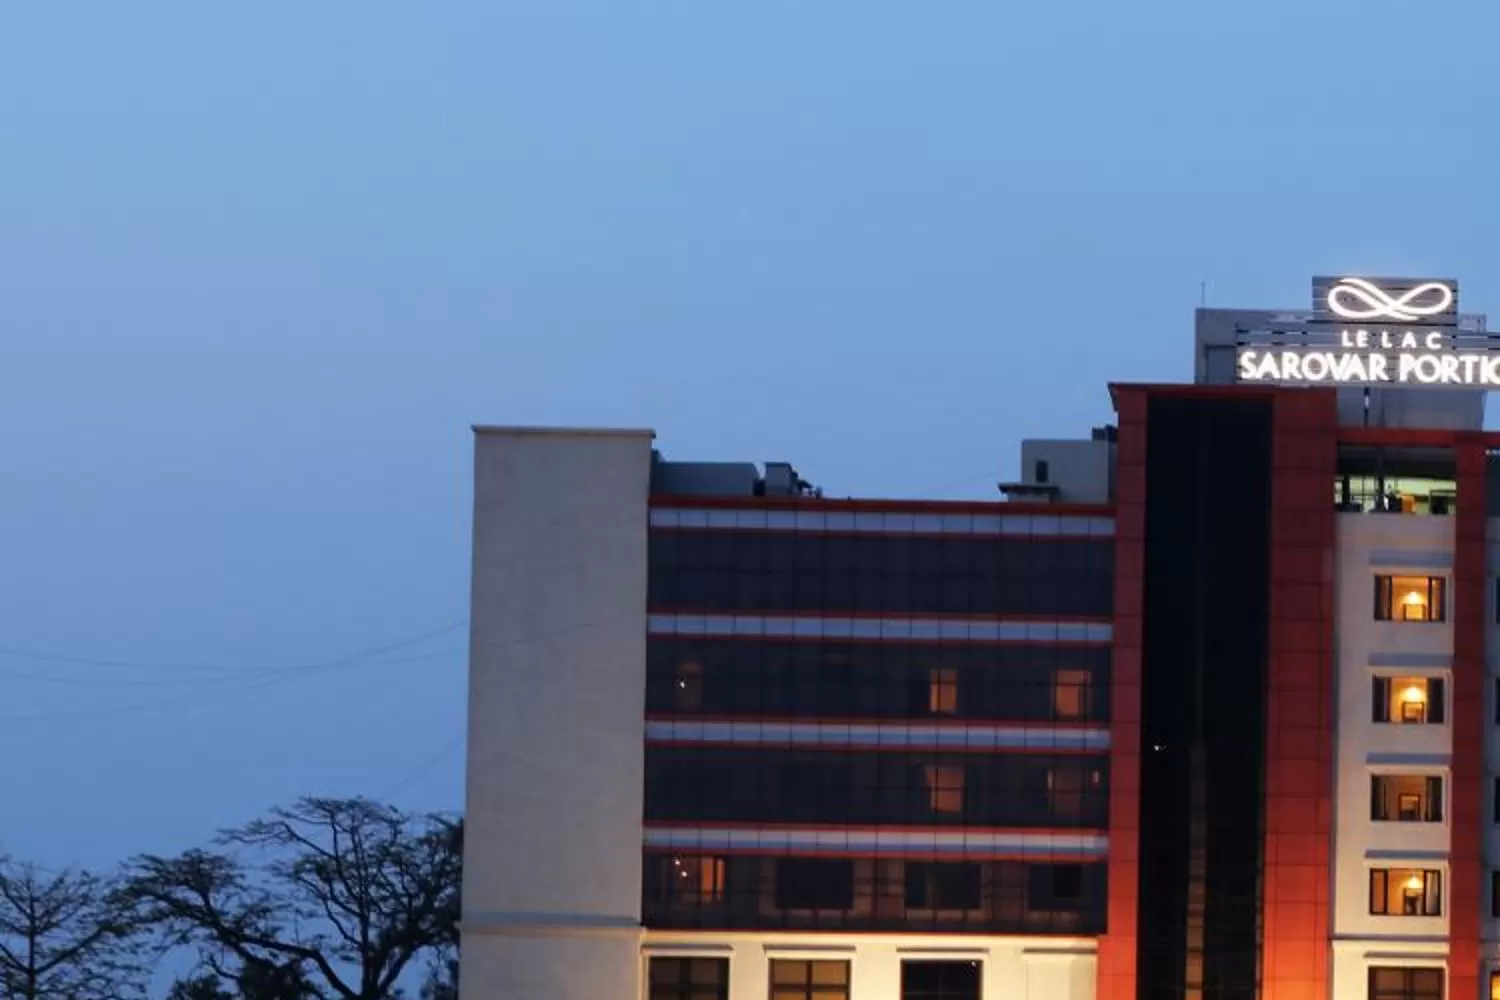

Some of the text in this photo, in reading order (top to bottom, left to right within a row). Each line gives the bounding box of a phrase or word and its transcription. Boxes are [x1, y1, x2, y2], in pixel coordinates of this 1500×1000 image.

[1341, 330, 1442, 349] LE LAC
[1239, 351, 1389, 381] SAROVAR
